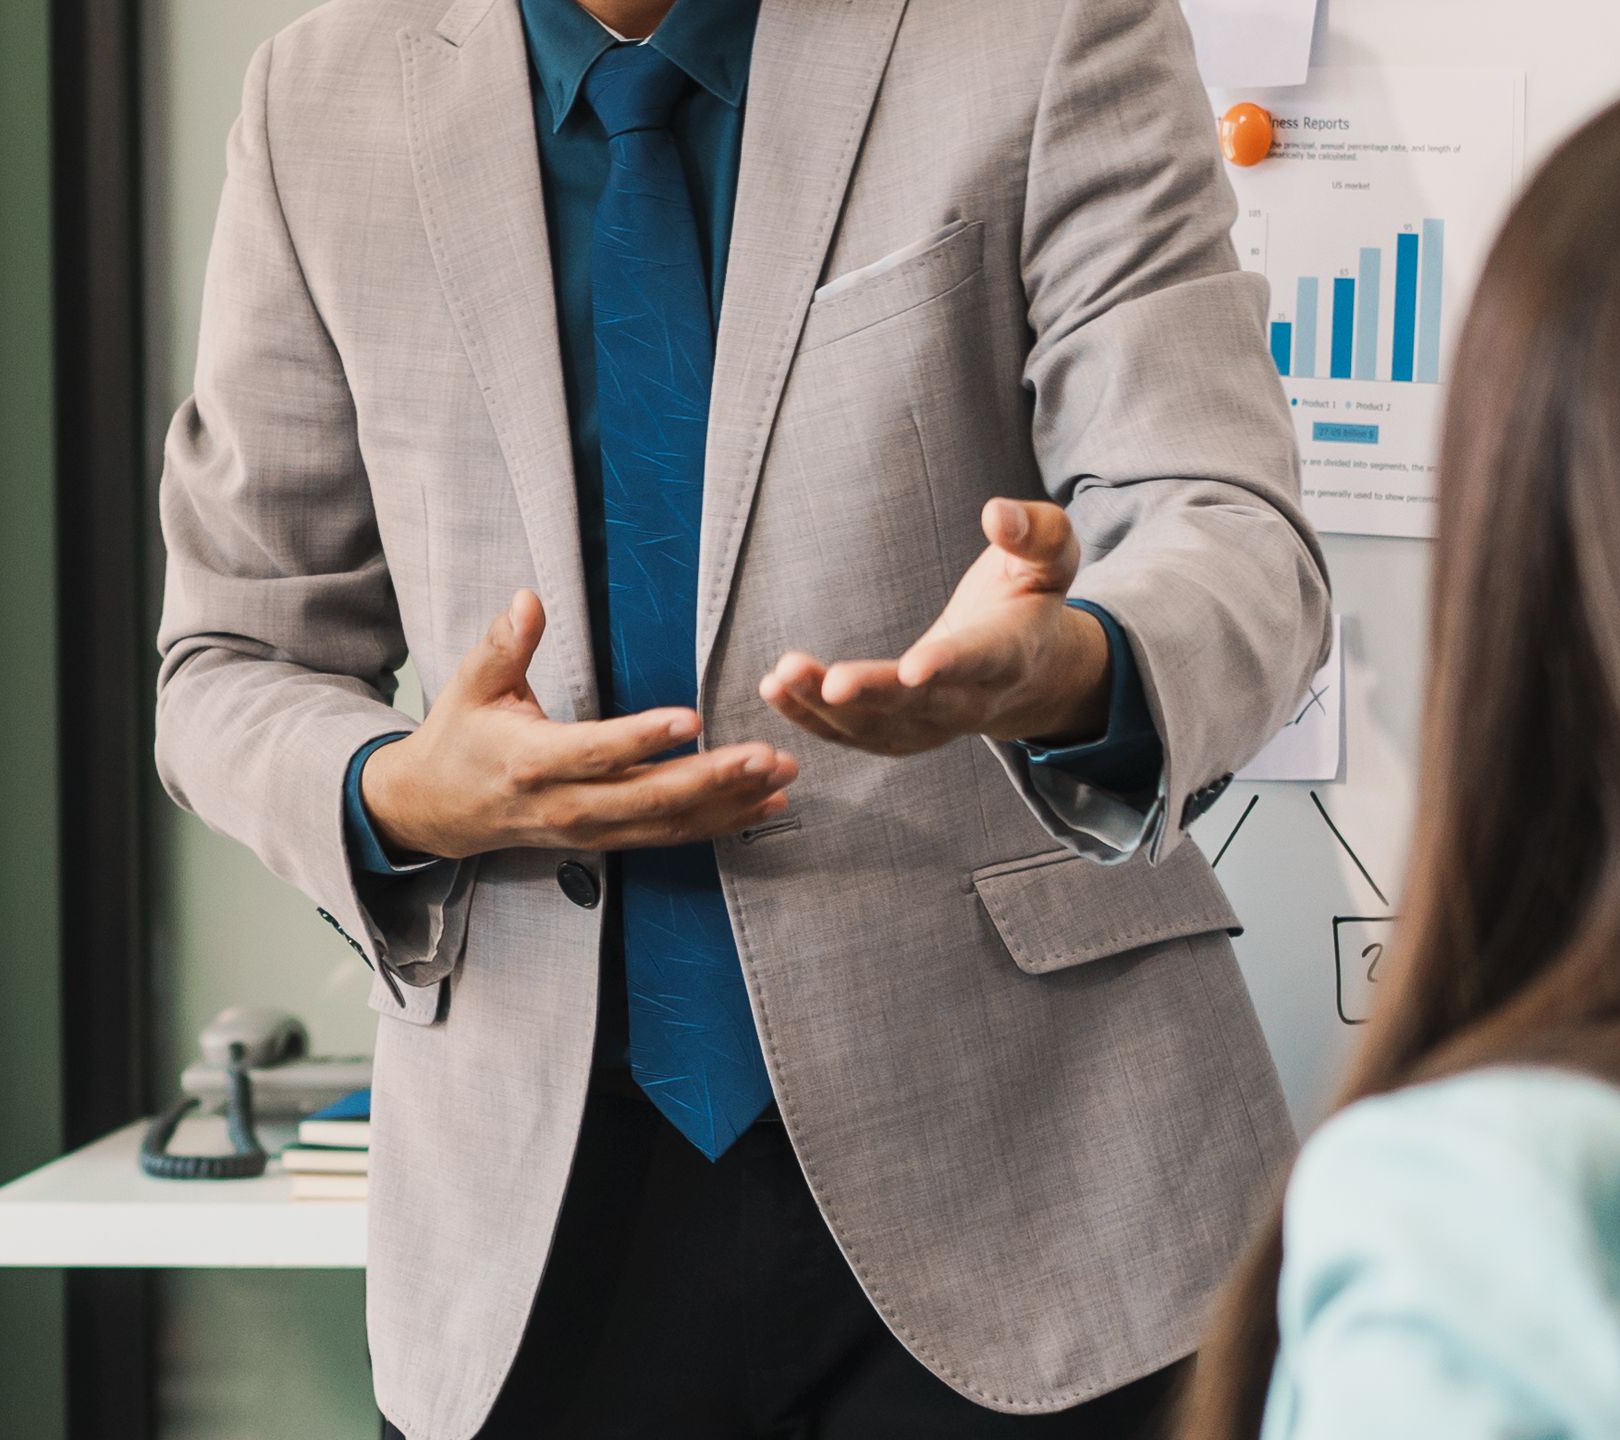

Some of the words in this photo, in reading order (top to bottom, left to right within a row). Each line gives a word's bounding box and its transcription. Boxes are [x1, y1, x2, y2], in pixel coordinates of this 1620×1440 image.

[1271, 118, 1299, 129] ness
[1303, 116, 1350, 131] Reports
[1345, 182, 1371, 190] market
